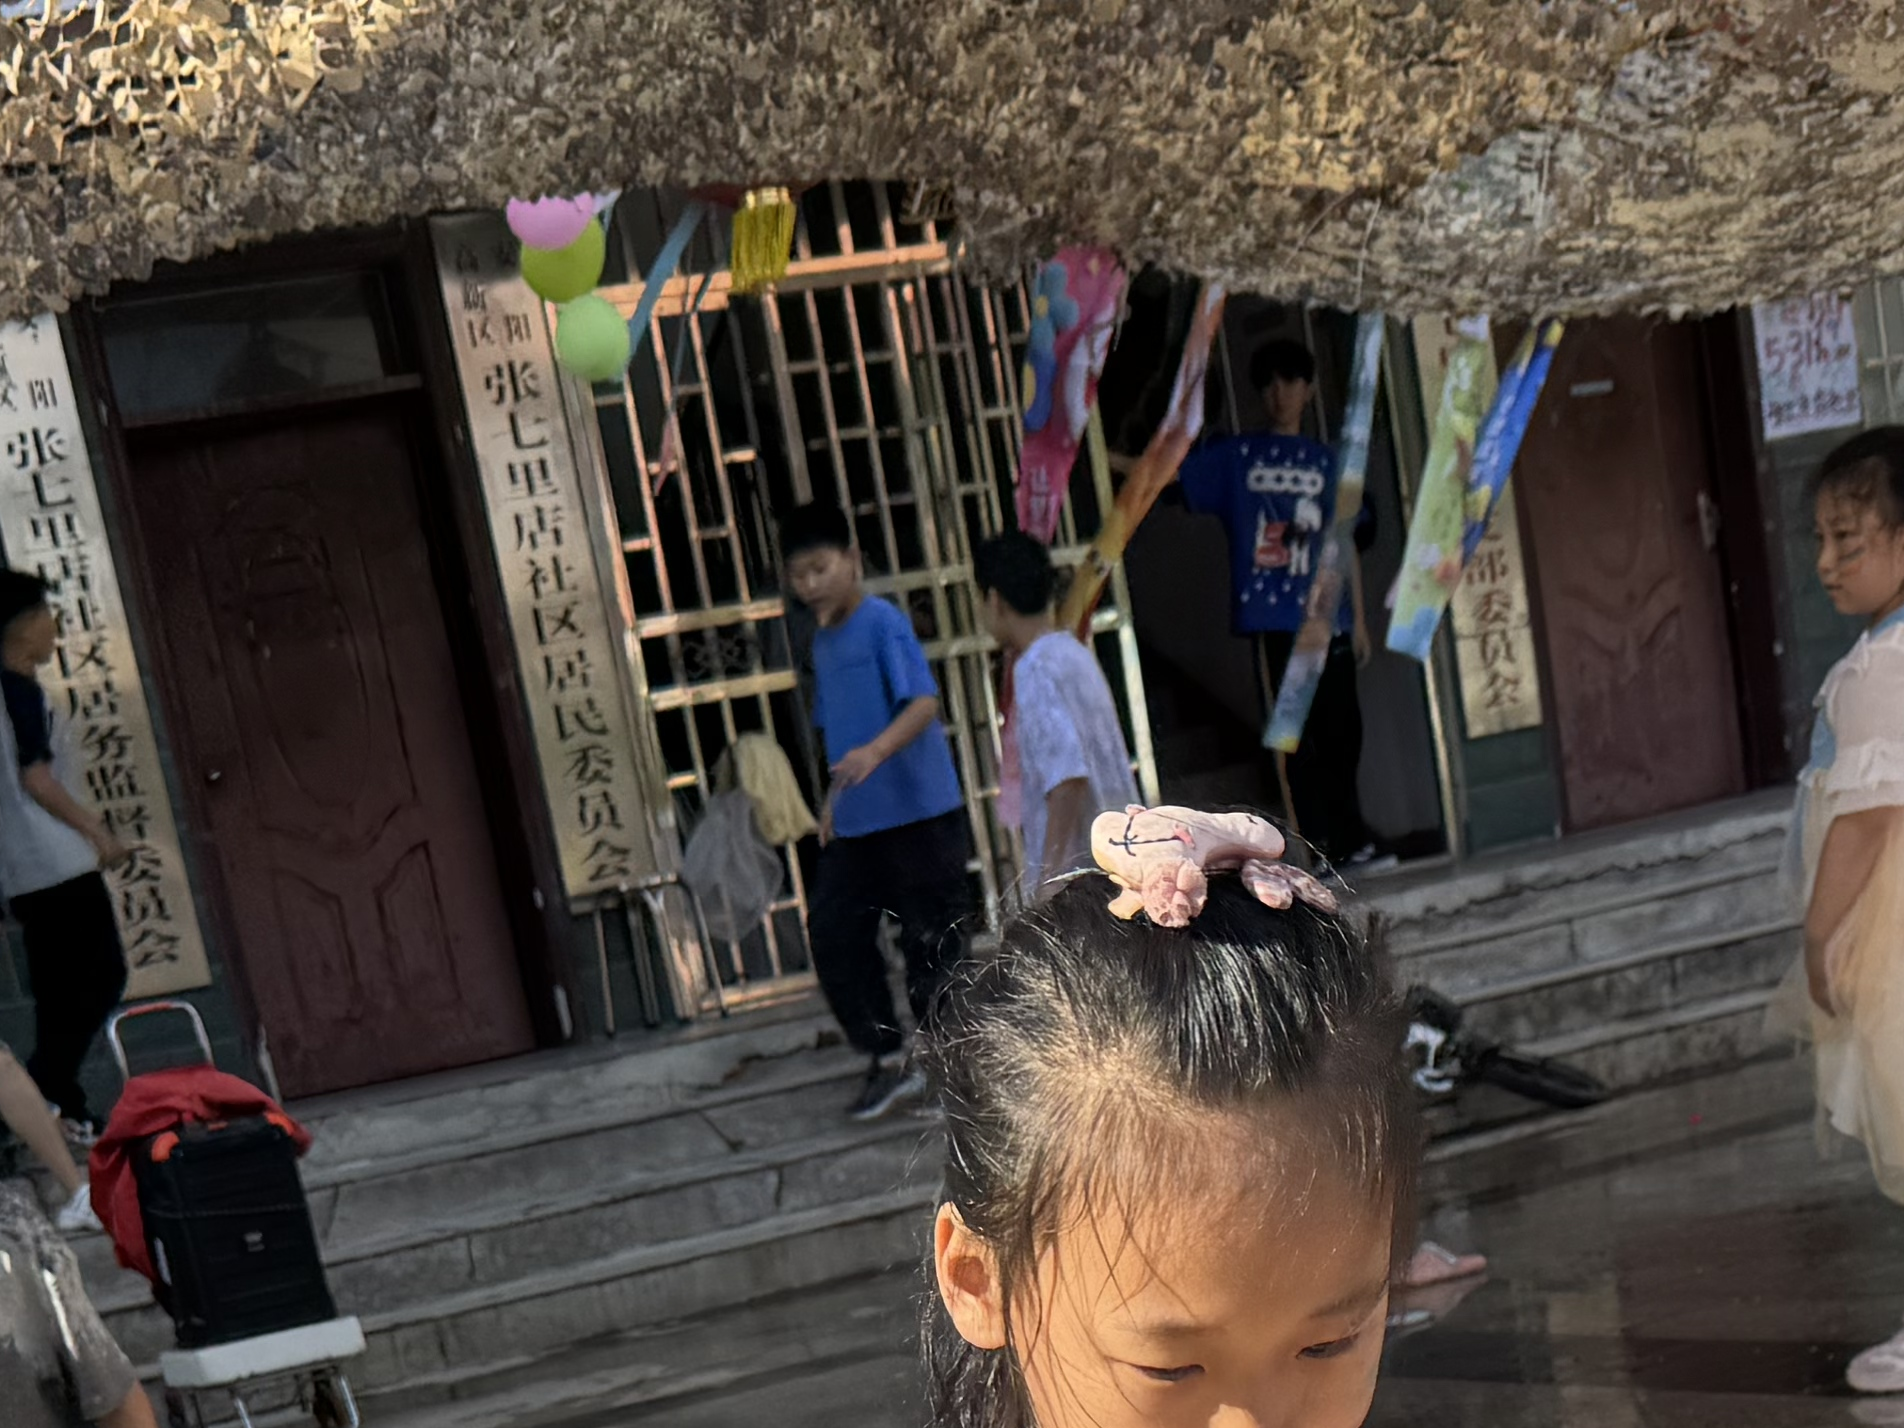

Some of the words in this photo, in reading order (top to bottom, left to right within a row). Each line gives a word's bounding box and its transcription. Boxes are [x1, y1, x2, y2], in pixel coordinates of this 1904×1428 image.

[483, 359, 631, 883] 张七里店社区居民委员会
